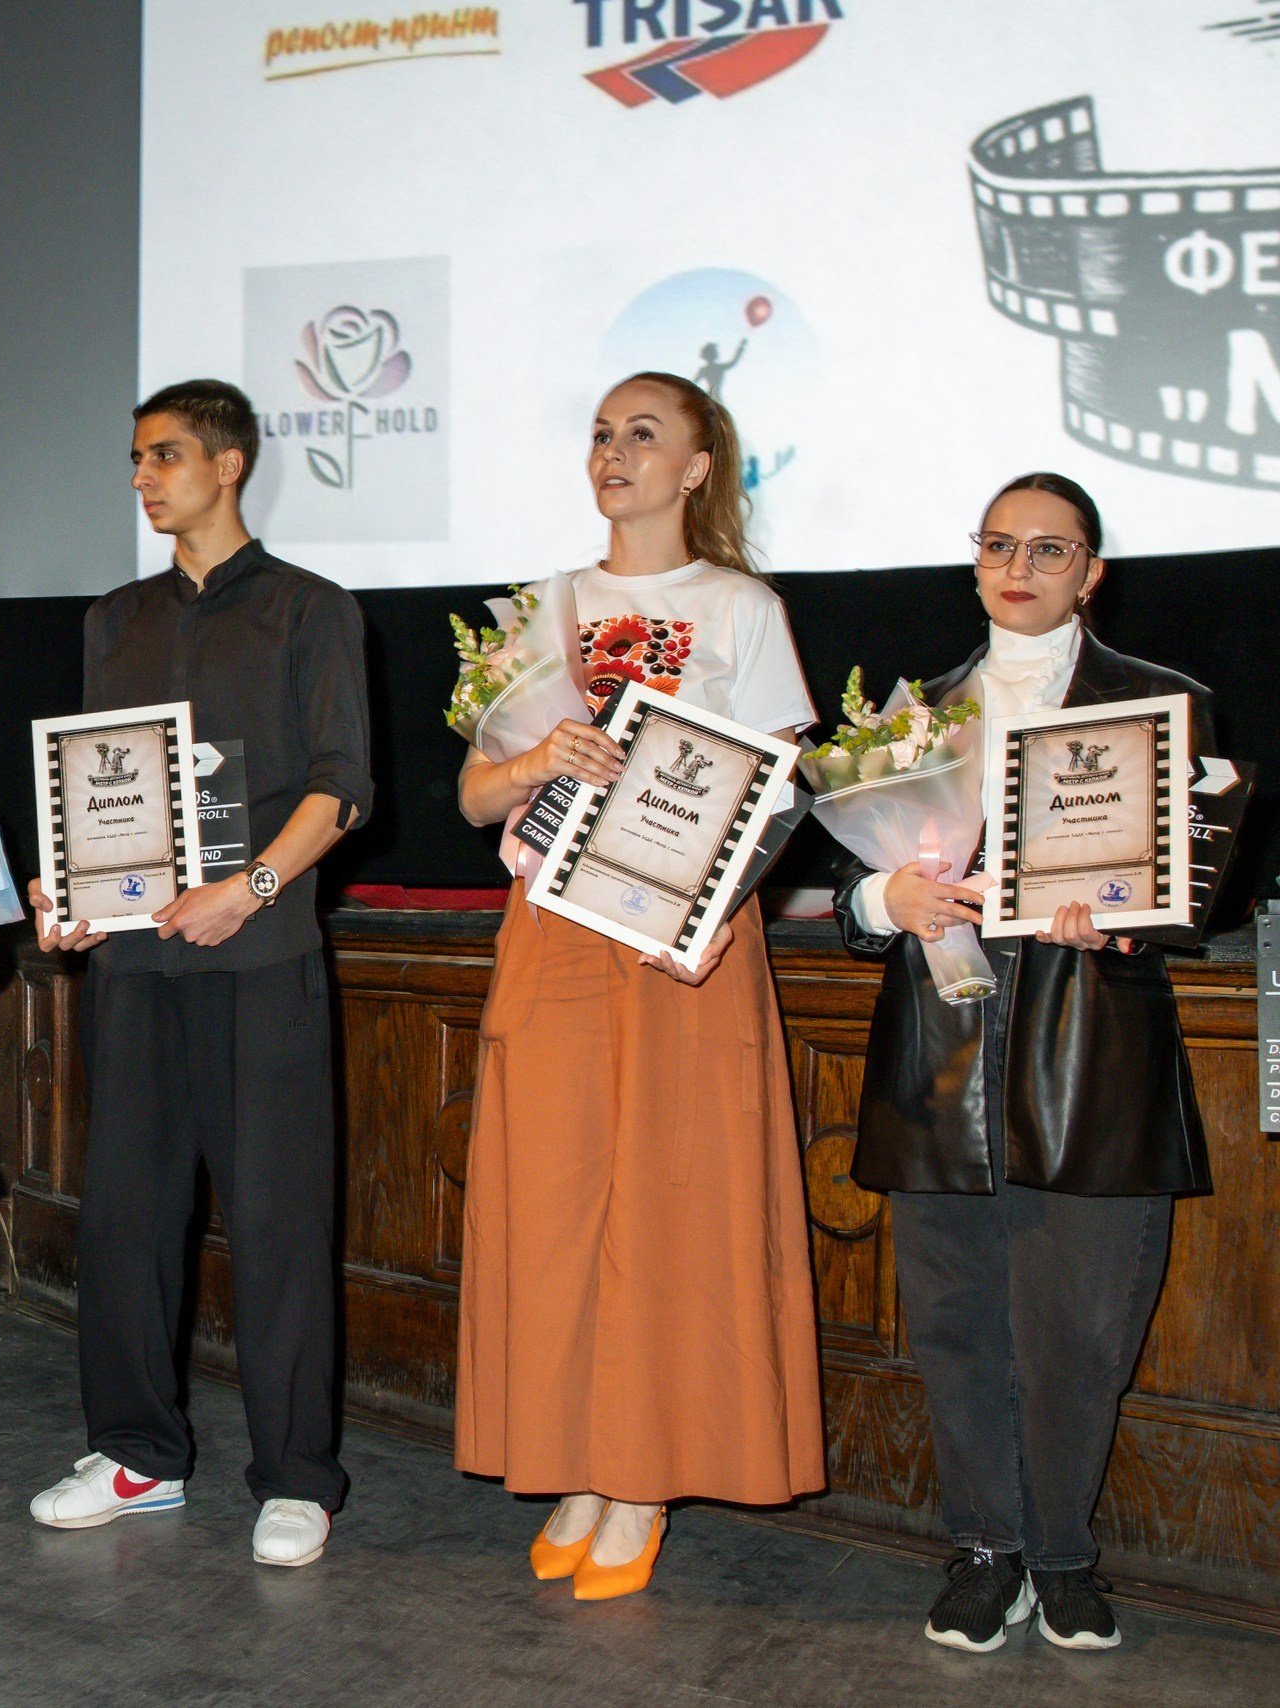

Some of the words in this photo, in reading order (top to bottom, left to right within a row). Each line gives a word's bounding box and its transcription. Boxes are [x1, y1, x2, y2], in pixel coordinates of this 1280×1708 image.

[258, 409, 345, 438] LOWER
[376, 406, 439, 434] HOLD
[86, 793, 144, 813] Диплом
[547, 789, 571, 810] PRO
[636, 788, 700, 826] Диплом
[1049, 791, 1122, 811] Диплом
[98, 816, 135, 826] Участника
[640, 814, 681, 838] Участника
[1061, 814, 1108, 825] Участника
